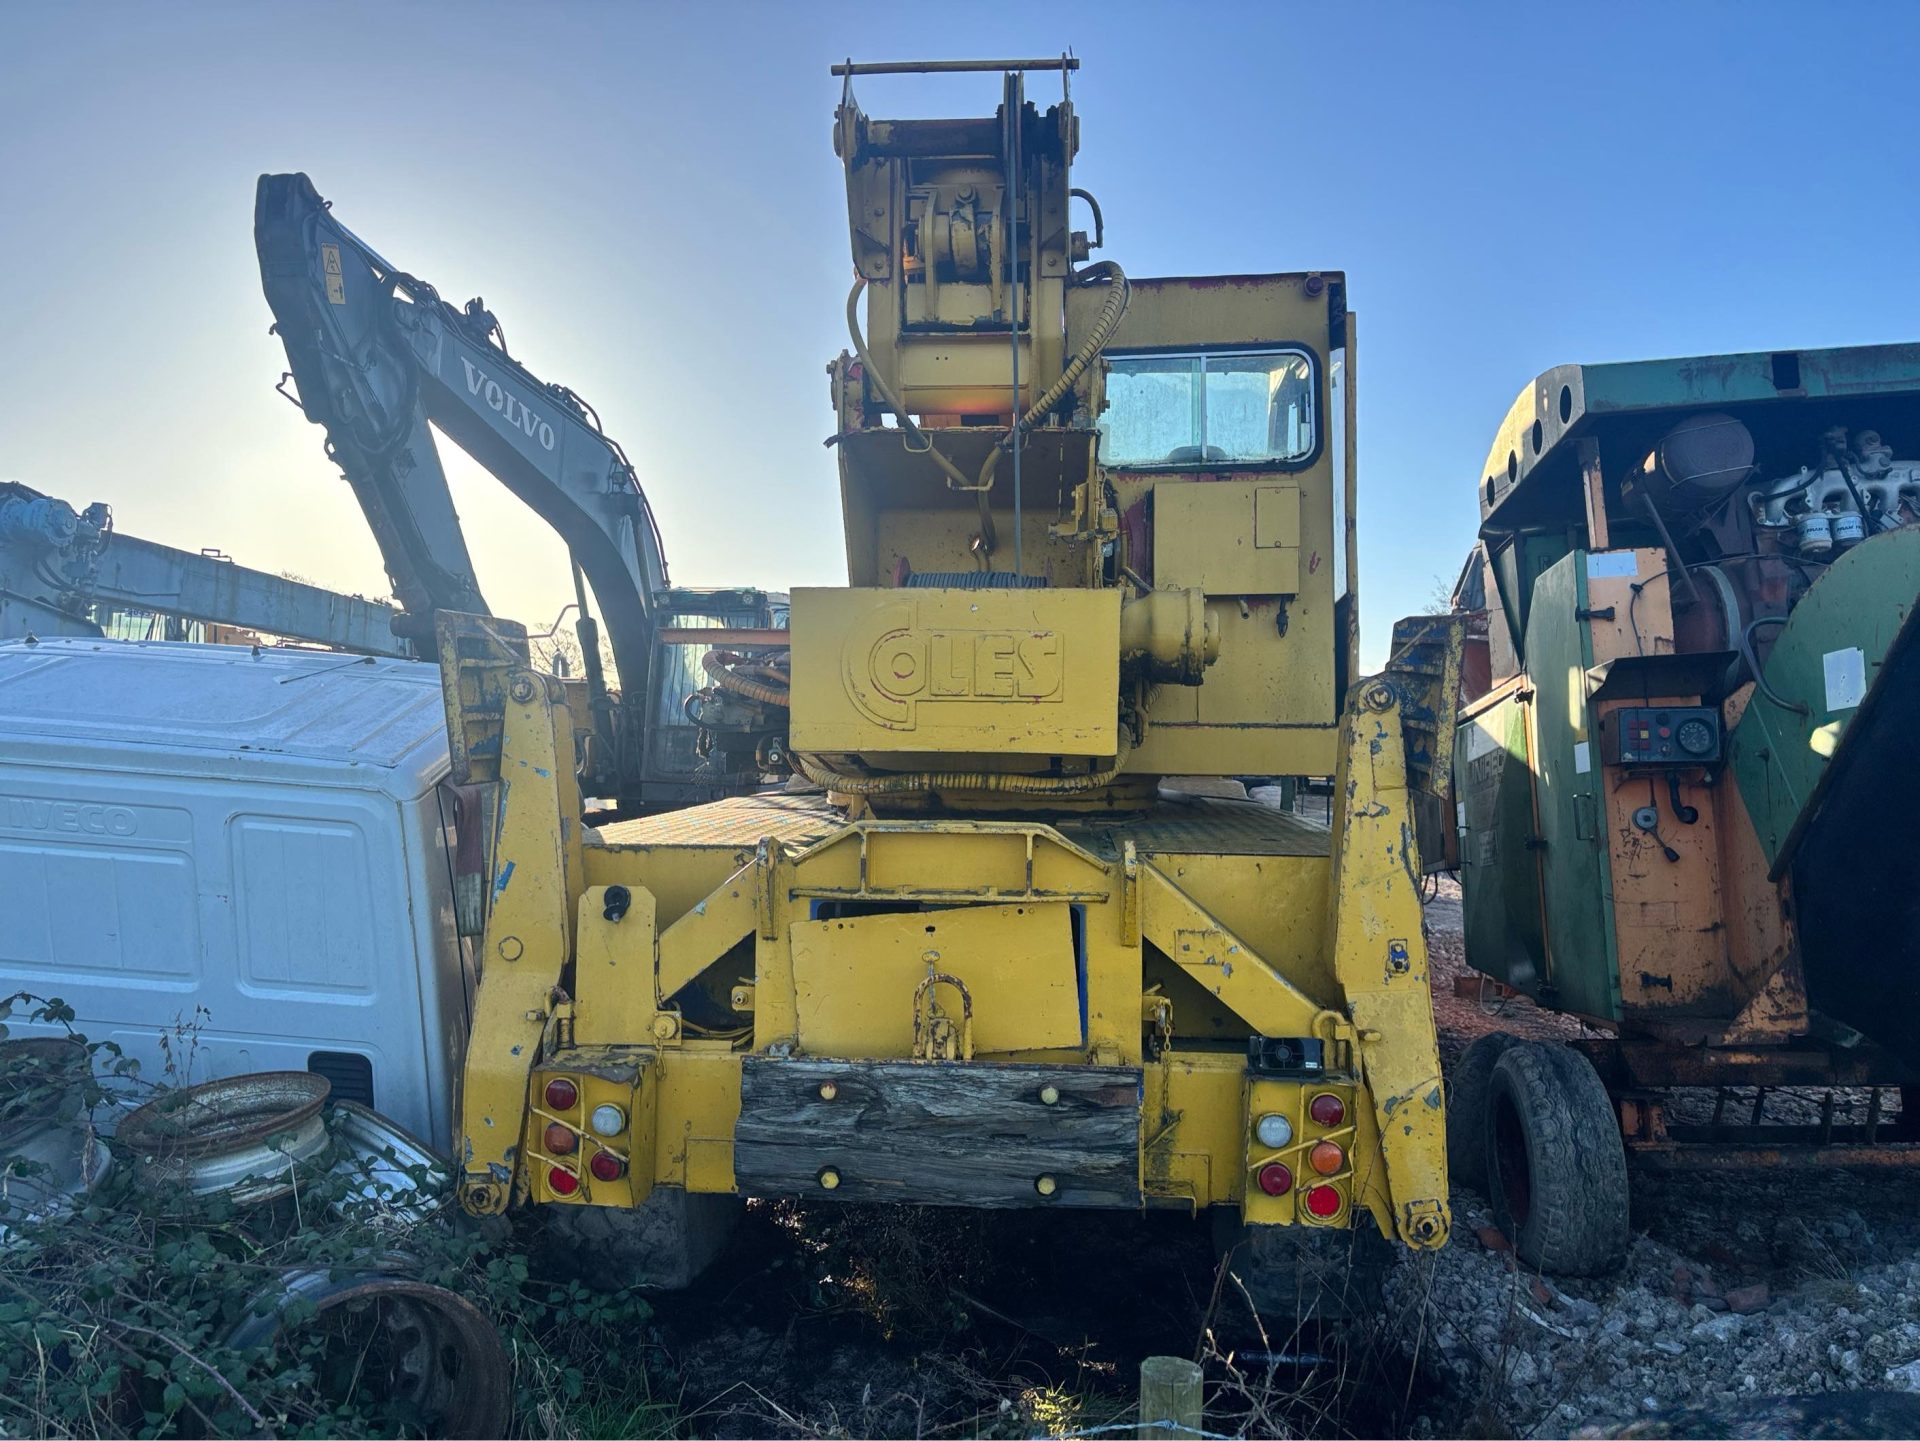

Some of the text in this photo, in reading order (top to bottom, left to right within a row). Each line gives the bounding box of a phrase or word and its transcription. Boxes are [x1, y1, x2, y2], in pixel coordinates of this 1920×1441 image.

[460, 355, 555, 451] VOLVO
[842, 600, 1064, 731] COLES
[7, 798, 138, 836] IVECO
